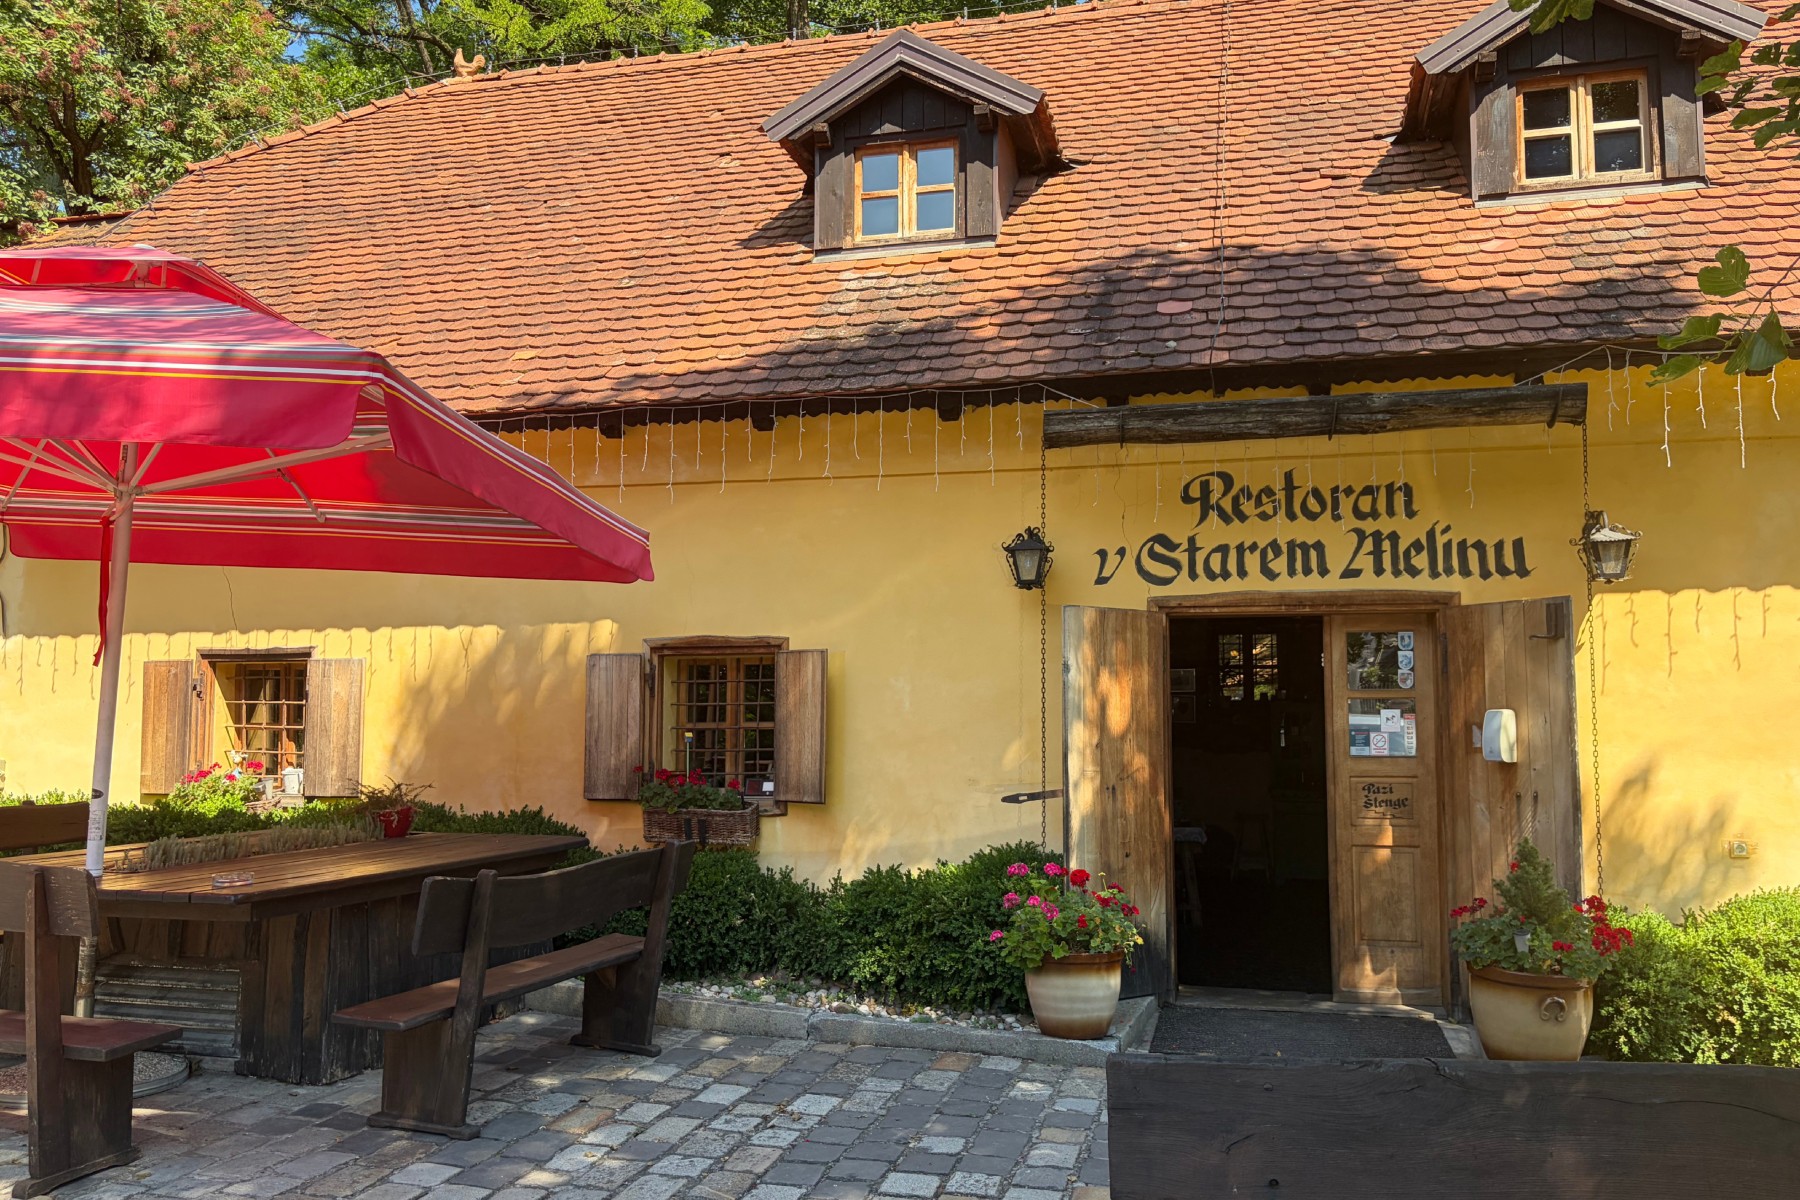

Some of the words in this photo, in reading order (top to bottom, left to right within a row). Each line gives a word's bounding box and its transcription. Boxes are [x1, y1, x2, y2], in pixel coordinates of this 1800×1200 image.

[1180, 467, 1421, 529] Restoran
[1093, 545, 1128, 587] v
[1134, 531, 1331, 587] Starem
[1338, 519, 1537, 582] Melinu
[1362, 783, 1394, 795] Pazi
